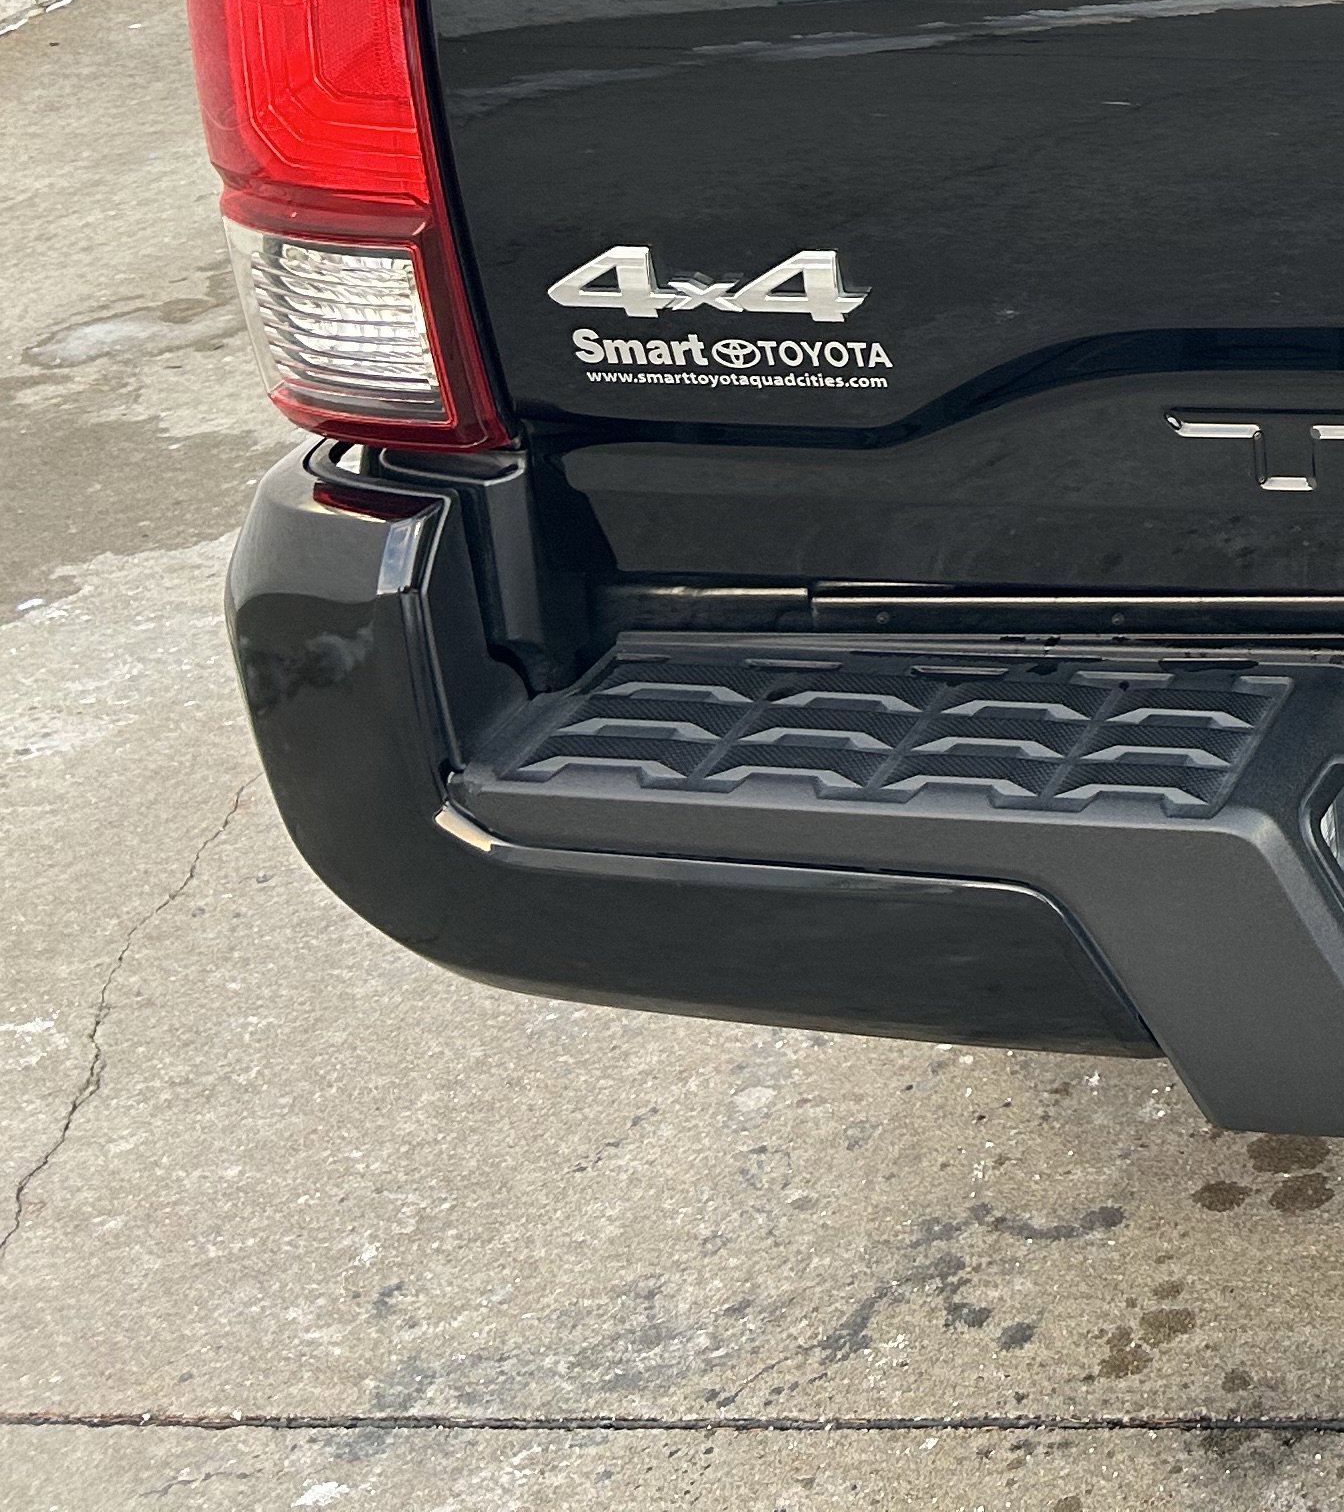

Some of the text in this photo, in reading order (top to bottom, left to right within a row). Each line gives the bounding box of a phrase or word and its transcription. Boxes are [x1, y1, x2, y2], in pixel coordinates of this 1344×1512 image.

[547, 245, 872, 322] 4x4
[572, 328, 893, 368] Smart TOYOTA
[586, 369, 888, 388] www.smarttoyotaquadcities.com
